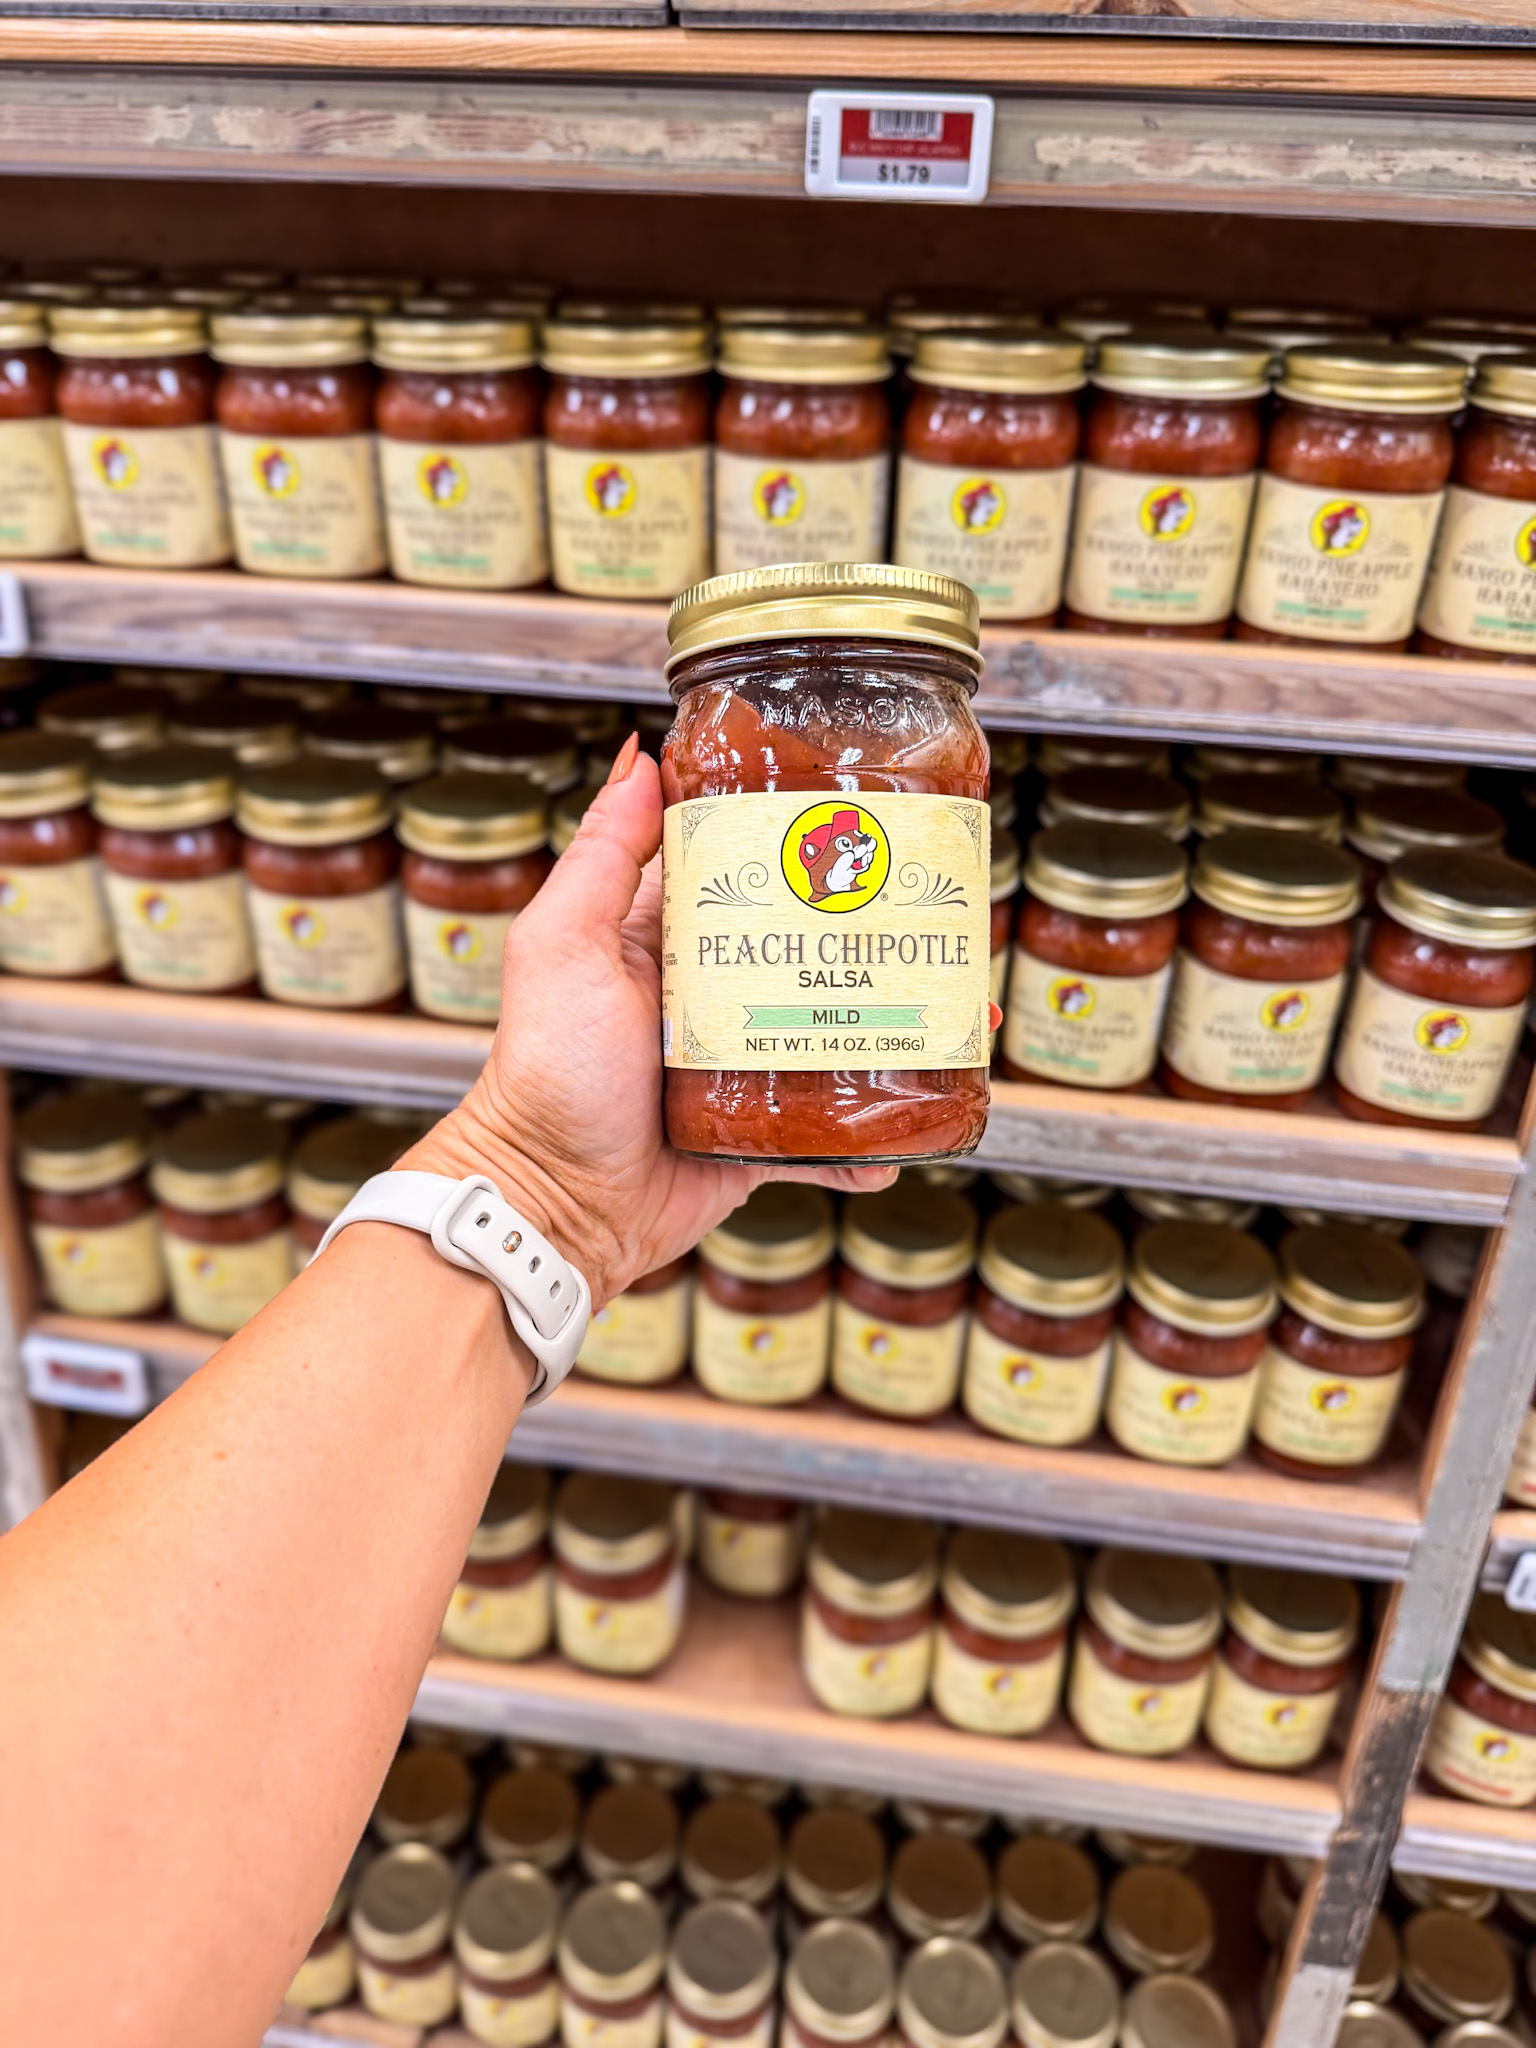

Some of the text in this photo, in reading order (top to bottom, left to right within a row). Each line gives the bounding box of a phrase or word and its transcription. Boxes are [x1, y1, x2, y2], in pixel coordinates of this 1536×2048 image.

[878, 163, 930, 184] $1.79
[761, 696, 934, 734] MASON
[698, 933, 807, 967] PEACH
[818, 933, 970, 967] CHIPOTLE
[798, 970, 874, 988] SALSA
[812, 1010, 861, 1025] MILD
[746, 1036, 925, 1052] NET WT. 14 OZ. (396G)
